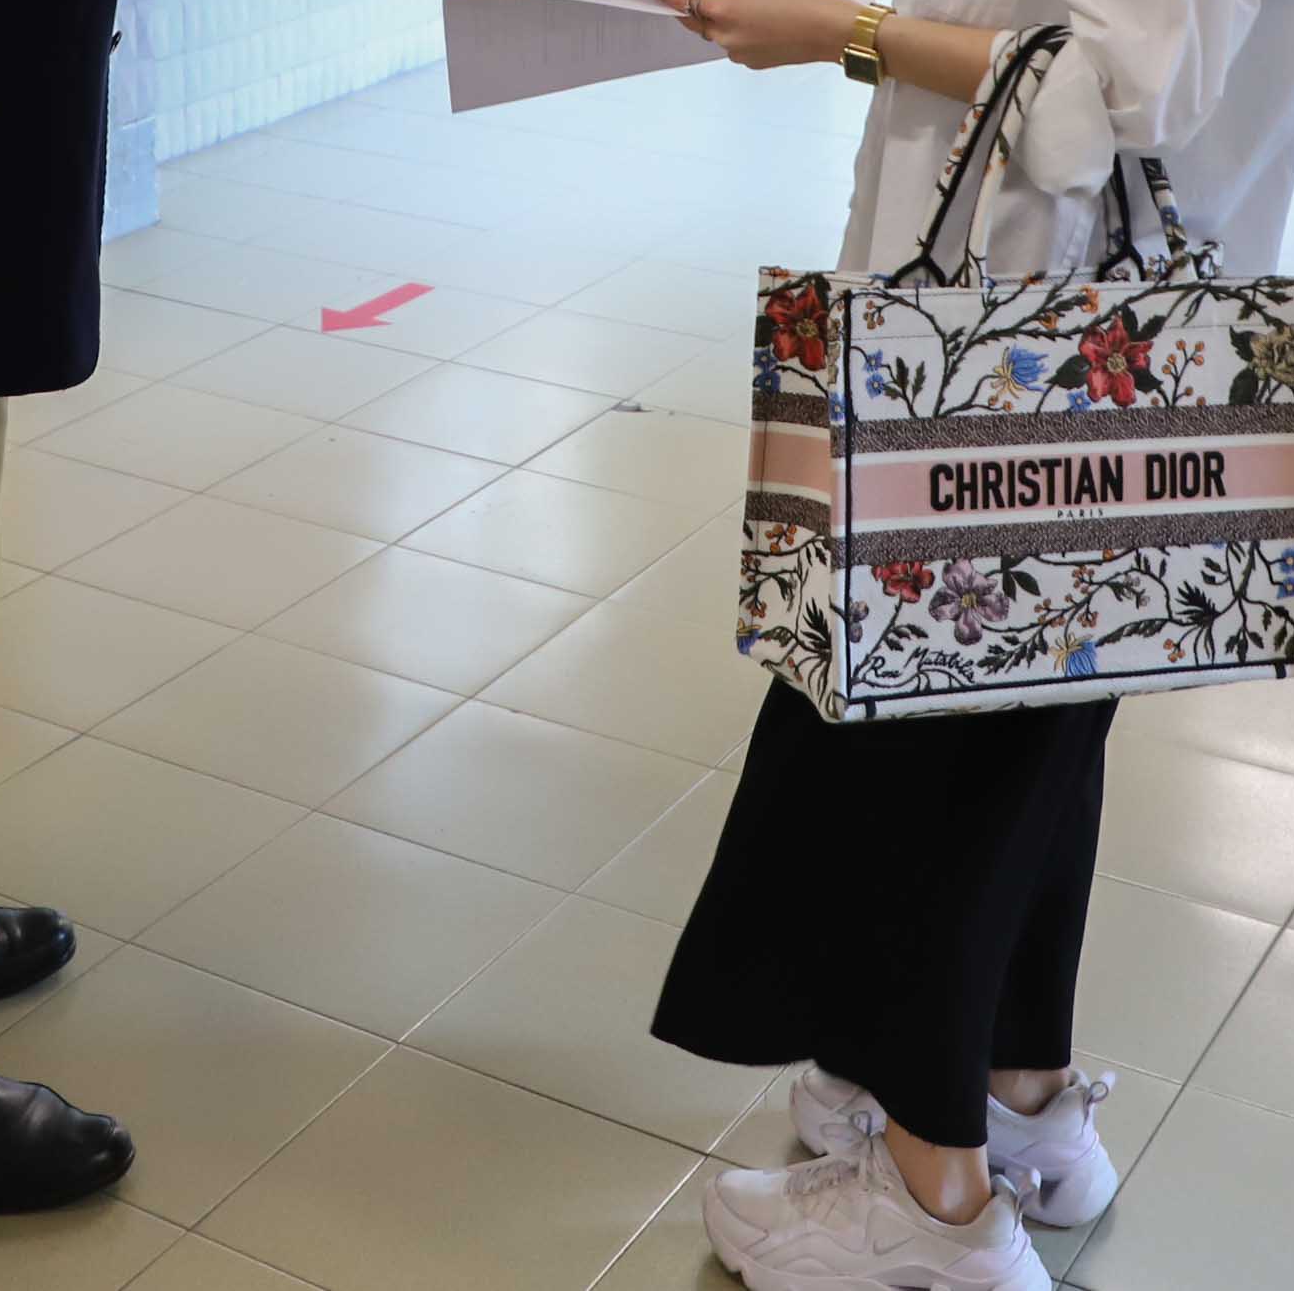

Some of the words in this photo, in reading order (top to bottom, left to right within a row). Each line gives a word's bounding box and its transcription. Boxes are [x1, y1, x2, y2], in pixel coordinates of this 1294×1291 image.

[929, 455, 1124, 511] CHRISTIAN
[1145, 451, 1226, 501] DIOR
[1057, 508, 1104, 518] PARIS
